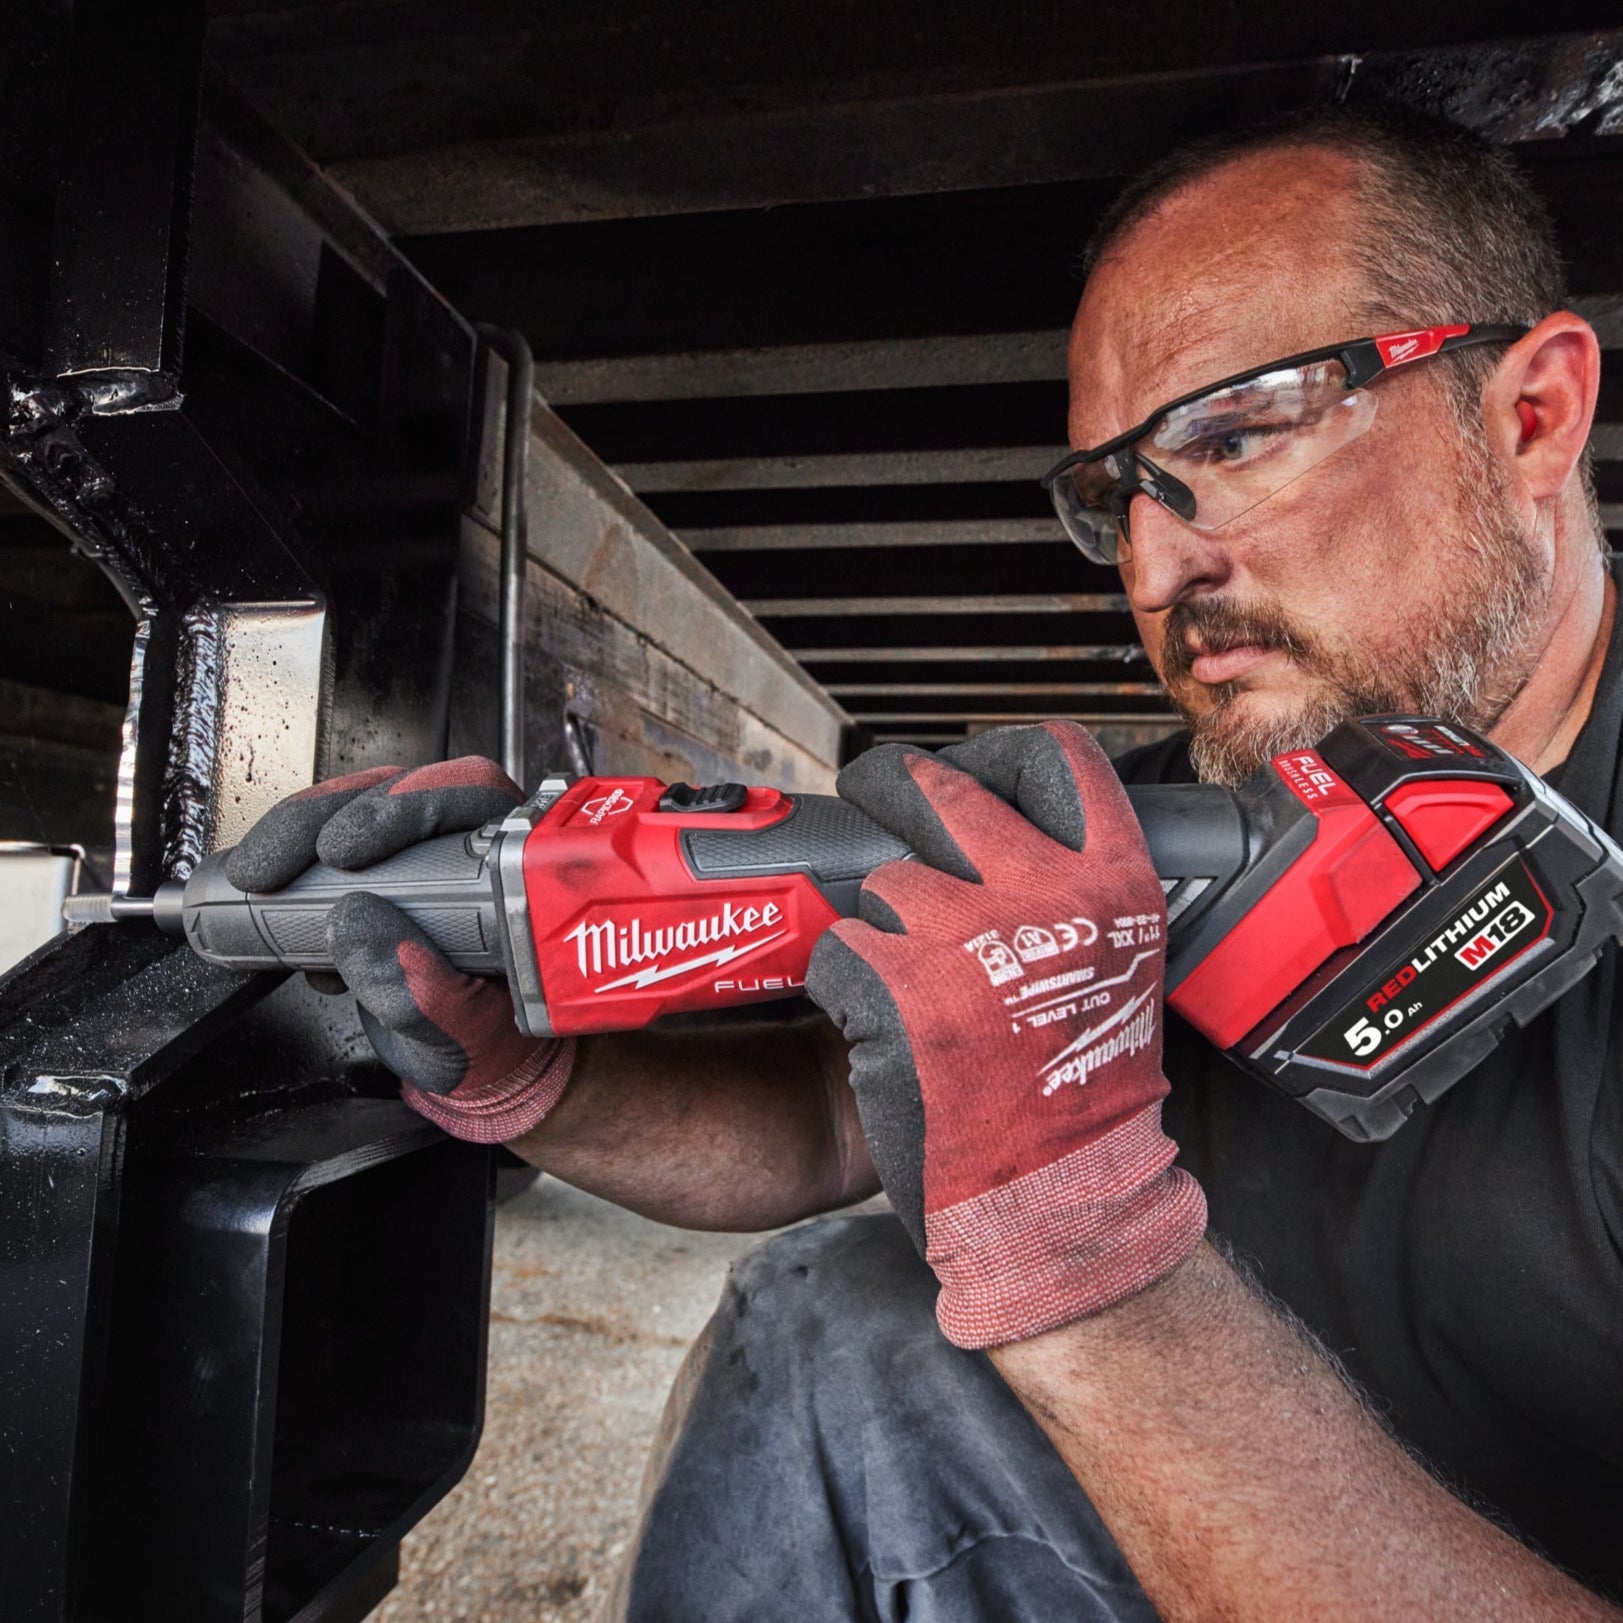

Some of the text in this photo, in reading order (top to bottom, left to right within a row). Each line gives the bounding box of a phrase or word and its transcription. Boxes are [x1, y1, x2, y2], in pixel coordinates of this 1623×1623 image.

[1278, 760, 1318, 799] BRUSHLESS
[1292, 756, 1336, 796] FUEL
[563, 902, 784, 979] Milwaukee
[1020, 930, 1043, 947] A1
[1107, 929, 1136, 948] XXL
[1365, 881, 1511, 1013] REDLITHIUM
[1459, 904, 1529, 967] M18
[714, 975, 807, 993] FUEL
[1011, 991, 1111, 1034] CUT LEVEL 1
[1343, 1000, 1423, 1057] 5.0 Ah
